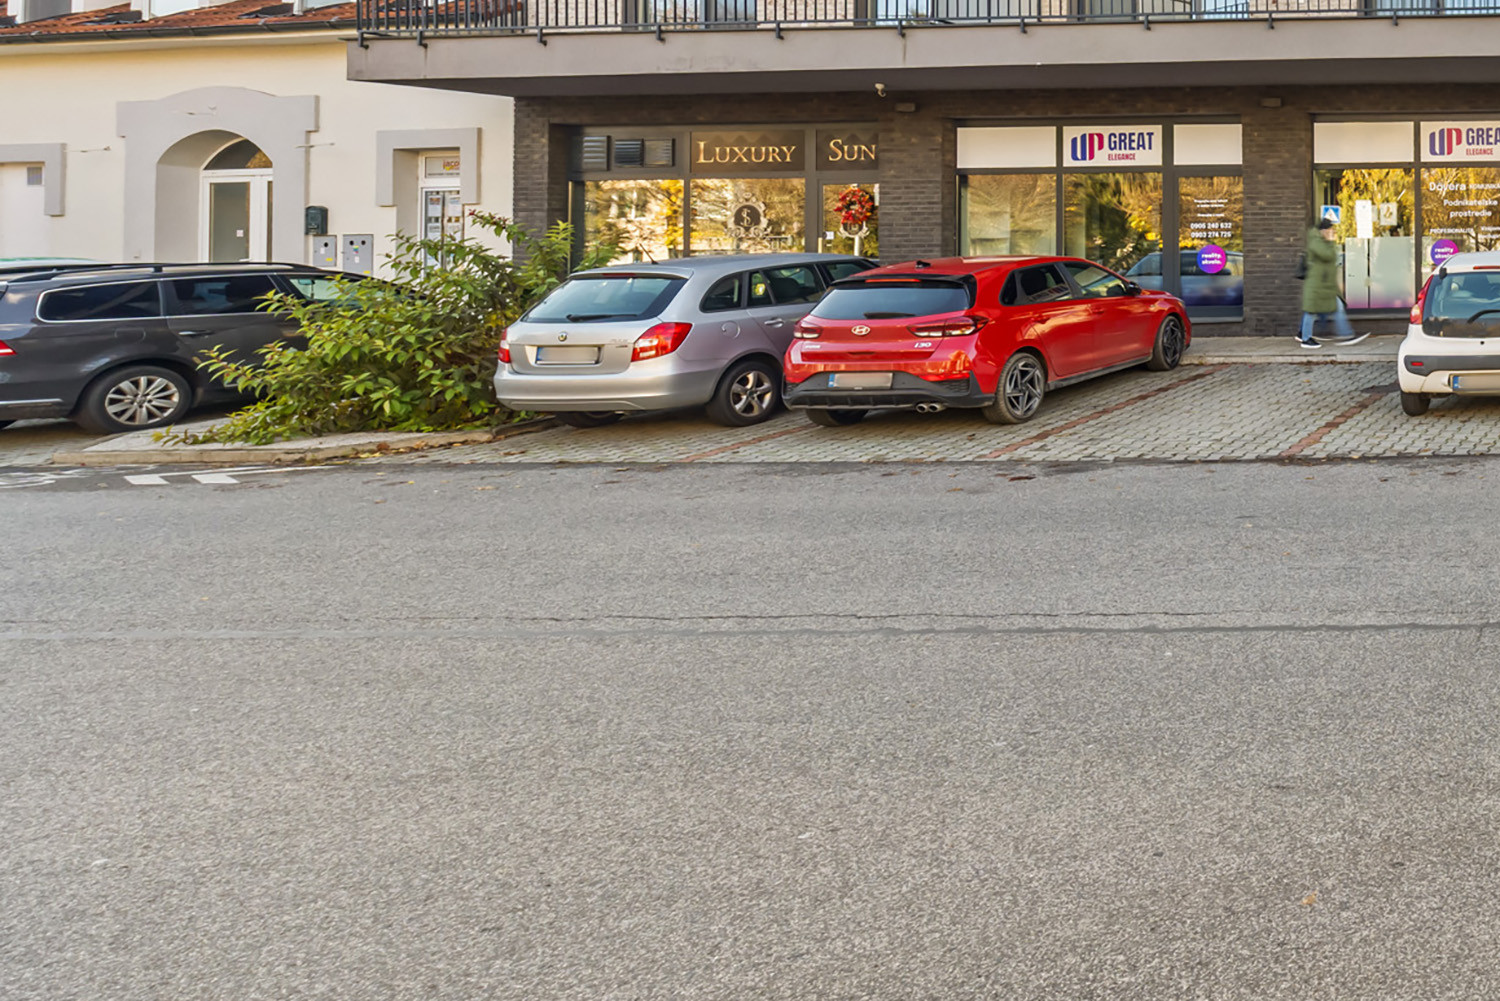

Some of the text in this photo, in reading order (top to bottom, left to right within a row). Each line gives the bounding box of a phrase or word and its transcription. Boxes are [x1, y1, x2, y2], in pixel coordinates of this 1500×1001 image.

[1108, 132, 1154, 151] GREAT
[1465, 147, 1494, 156] ELEGANCE
[1108, 153, 1136, 161] ELEGANCE
